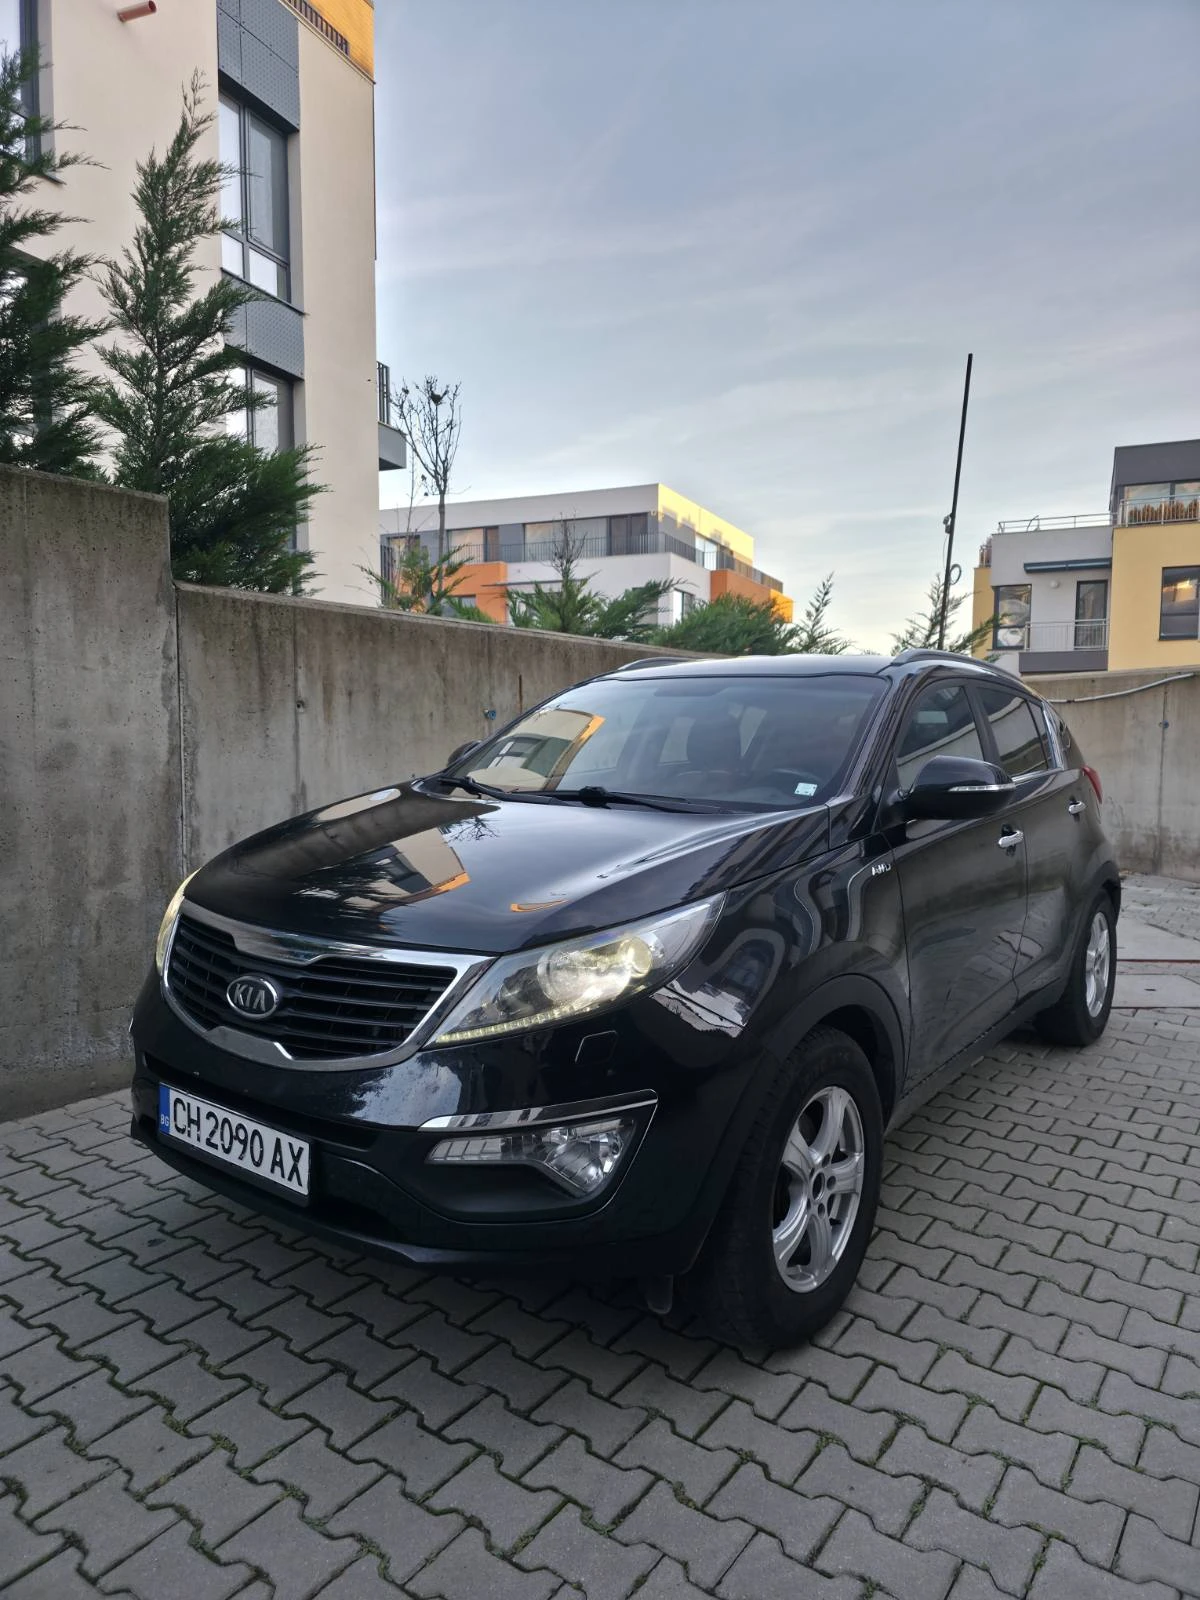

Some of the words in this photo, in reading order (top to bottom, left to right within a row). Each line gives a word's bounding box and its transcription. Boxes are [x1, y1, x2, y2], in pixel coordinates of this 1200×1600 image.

[234, 983, 266, 1012] KIA
[160, 1113, 170, 1127] BG
[205, 1111, 264, 1168] 2090
[270, 1137, 304, 1187] AX
